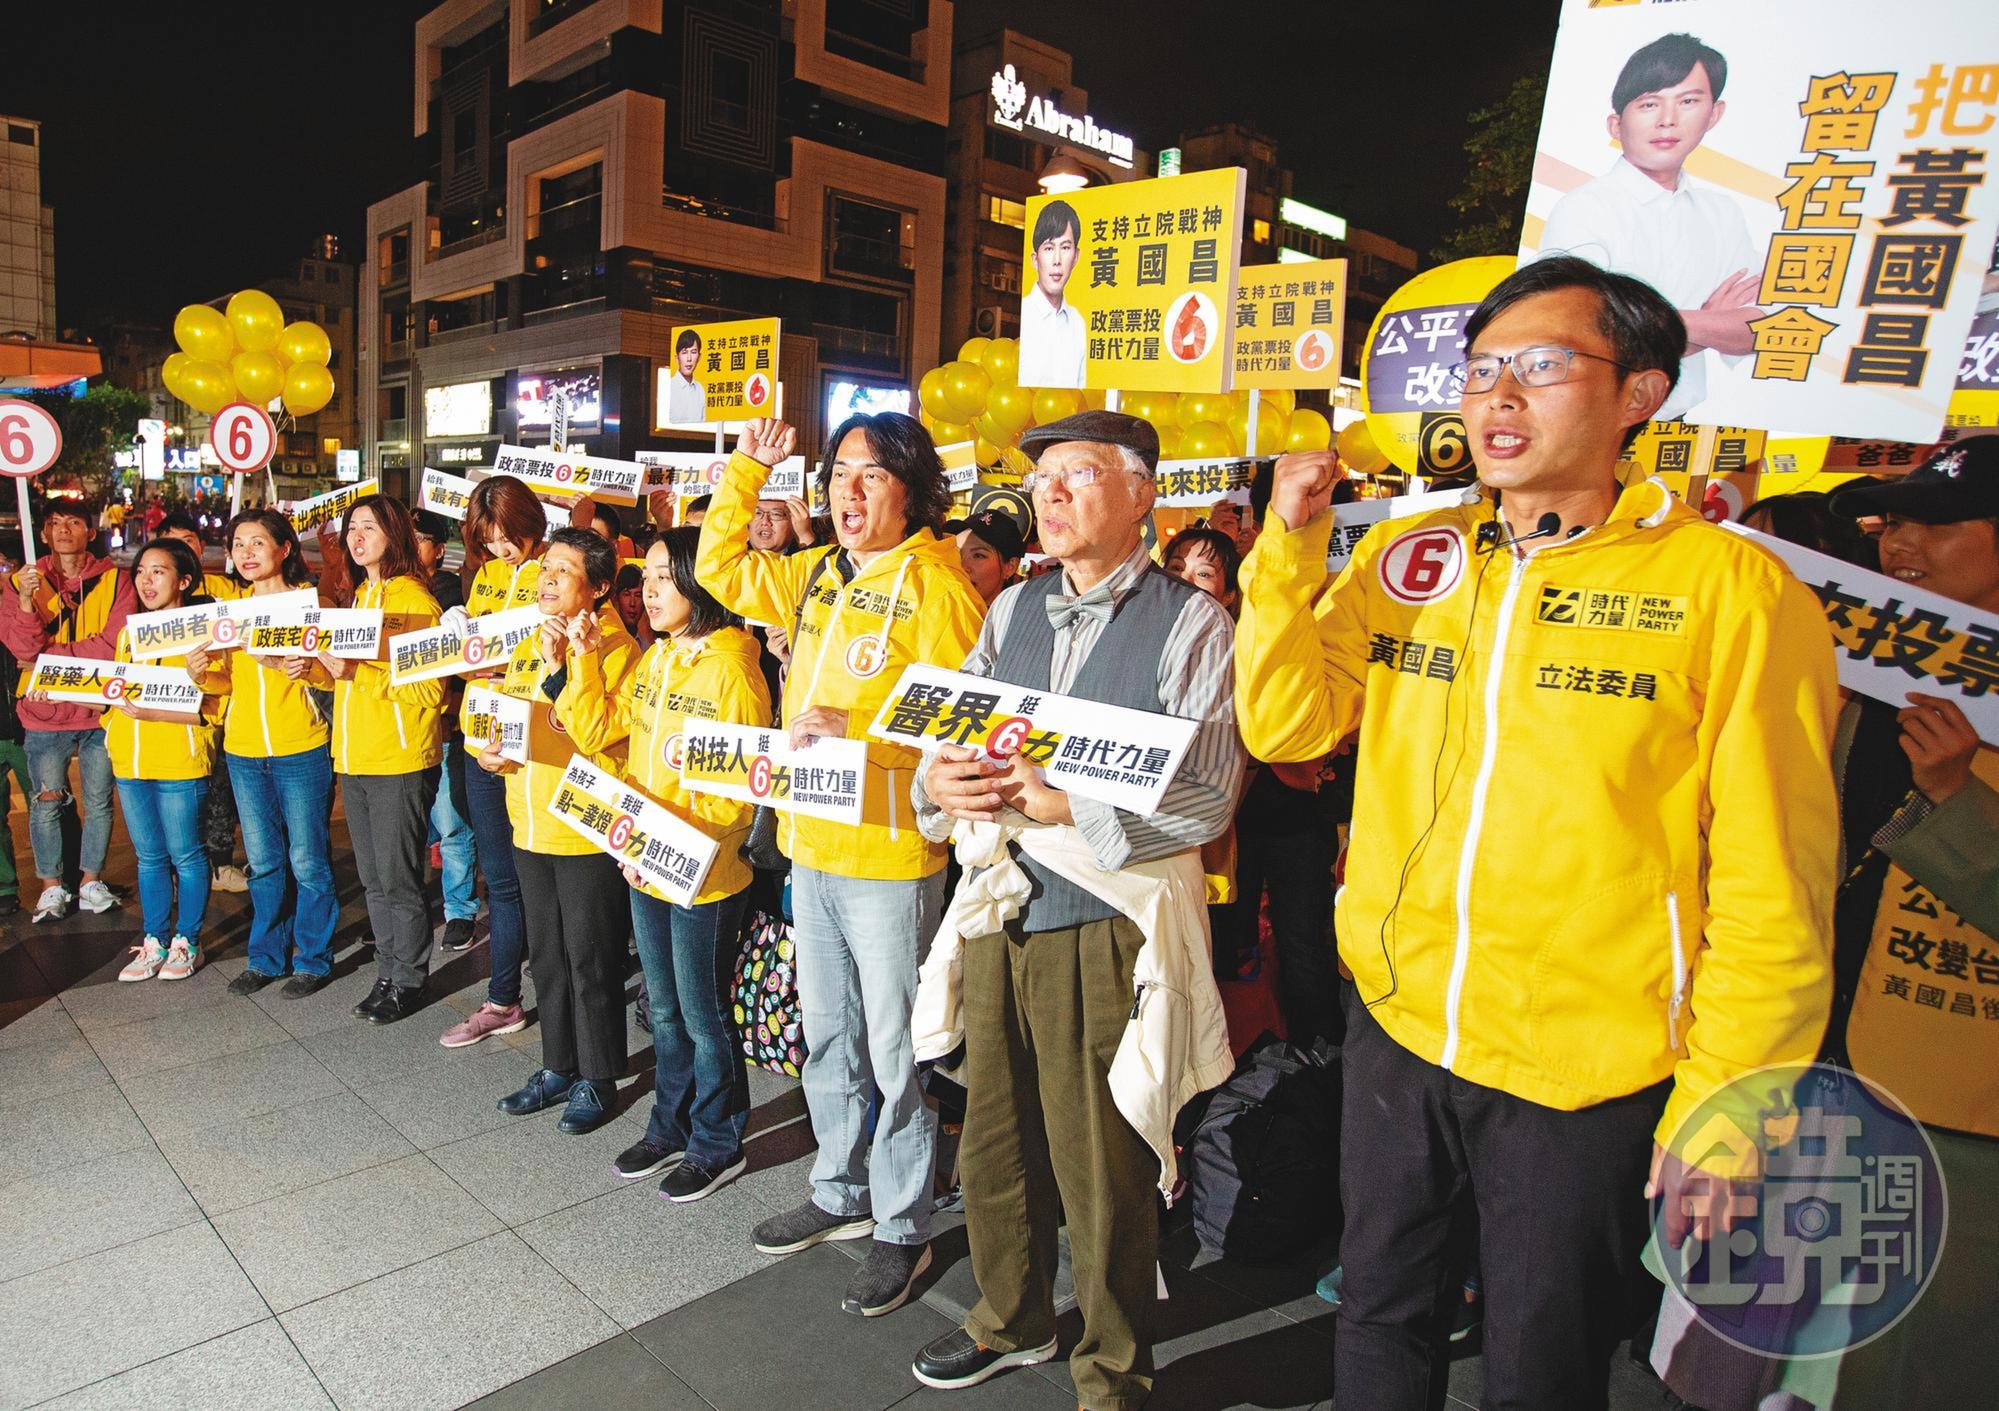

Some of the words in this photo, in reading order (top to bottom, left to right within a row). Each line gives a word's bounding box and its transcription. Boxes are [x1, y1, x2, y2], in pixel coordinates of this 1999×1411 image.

[1025, 96, 1134, 163] Abraham
[1091, 205, 1223, 243] 支持立院戰神
[1745, 70, 1898, 382] 留在國會
[1841, 63, 1999, 389] 把黃國昌
[1090, 239, 1218, 288] 黃國昌
[1236, 279, 1335, 301] 支持立院戰神
[1091, 308, 1162, 333] 政黨票投
[1171, 295, 1207, 361] 6
[1235, 299, 1333, 328] 黃國昌
[707, 334, 771, 350] 支持立院戰神
[1236, 339, 1292, 355] 政黨票投
[1376, 310, 1475, 356] 公平
[707, 348, 770, 372] 黃國昌
[1090, 338, 1160, 361] 時代力量
[1236, 357, 1292, 372] 時代力量
[1301, 333, 1325, 368] 6
[707, 380, 743, 394] 政黨票投
[707, 394, 743, 407] 時代力量
[750, 377, 765, 406] 6
[0, 415, 34, 465] 6
[229, 415, 253, 461] 6
[1430, 422, 1467, 468] 6
[498, 456, 556, 478] 政黨票投
[591, 469, 637, 486] 時代力量
[1401, 538, 1450, 592] 6
[1590, 593, 1628, 611] 時代
[1639, 608, 1684, 620] POWER
[1642, 597, 1671, 608] NEW
[136, 612, 210, 646] 吹哨者
[1588, 610, 1625, 627] 力量
[1637, 619, 1679, 631] PARTY
[256, 626, 302, 648] 政策宅
[334, 626, 376, 643] 時代力量
[397, 633, 461, 672] 獸醫師
[1366, 632, 1456, 682] 黃國昌
[38, 666, 103, 687] 醫藥人
[145, 683, 198, 697] 時代力量
[1536, 664, 1657, 701] 立法委員
[1016, 695, 1042, 715] 挺
[758, 733, 770, 753] 挺
[886, 682, 1001, 746] 醫界
[1062, 736, 1171, 775] 時代力量
[686, 734, 749, 774] 科技人
[794, 767, 857, 794] 時代力量
[1054, 760, 1079, 775] NEW
[1080, 764, 1120, 782] POWER
[1120, 770, 1160, 789] PARTY
[567, 766, 597, 791] 為孩子
[620, 793, 644, 817] 我挺
[793, 792, 809, 802] NEW
[809, 793, 833, 805] POWER
[833, 796, 856, 807] PARTY
[555, 788, 614, 837] 點一盞燈
[646, 838, 701, 881] 時代力量
[641, 858, 656, 871] NEW
[653, 864, 674, 882] POWER
[672, 875, 693, 892] PARTY
